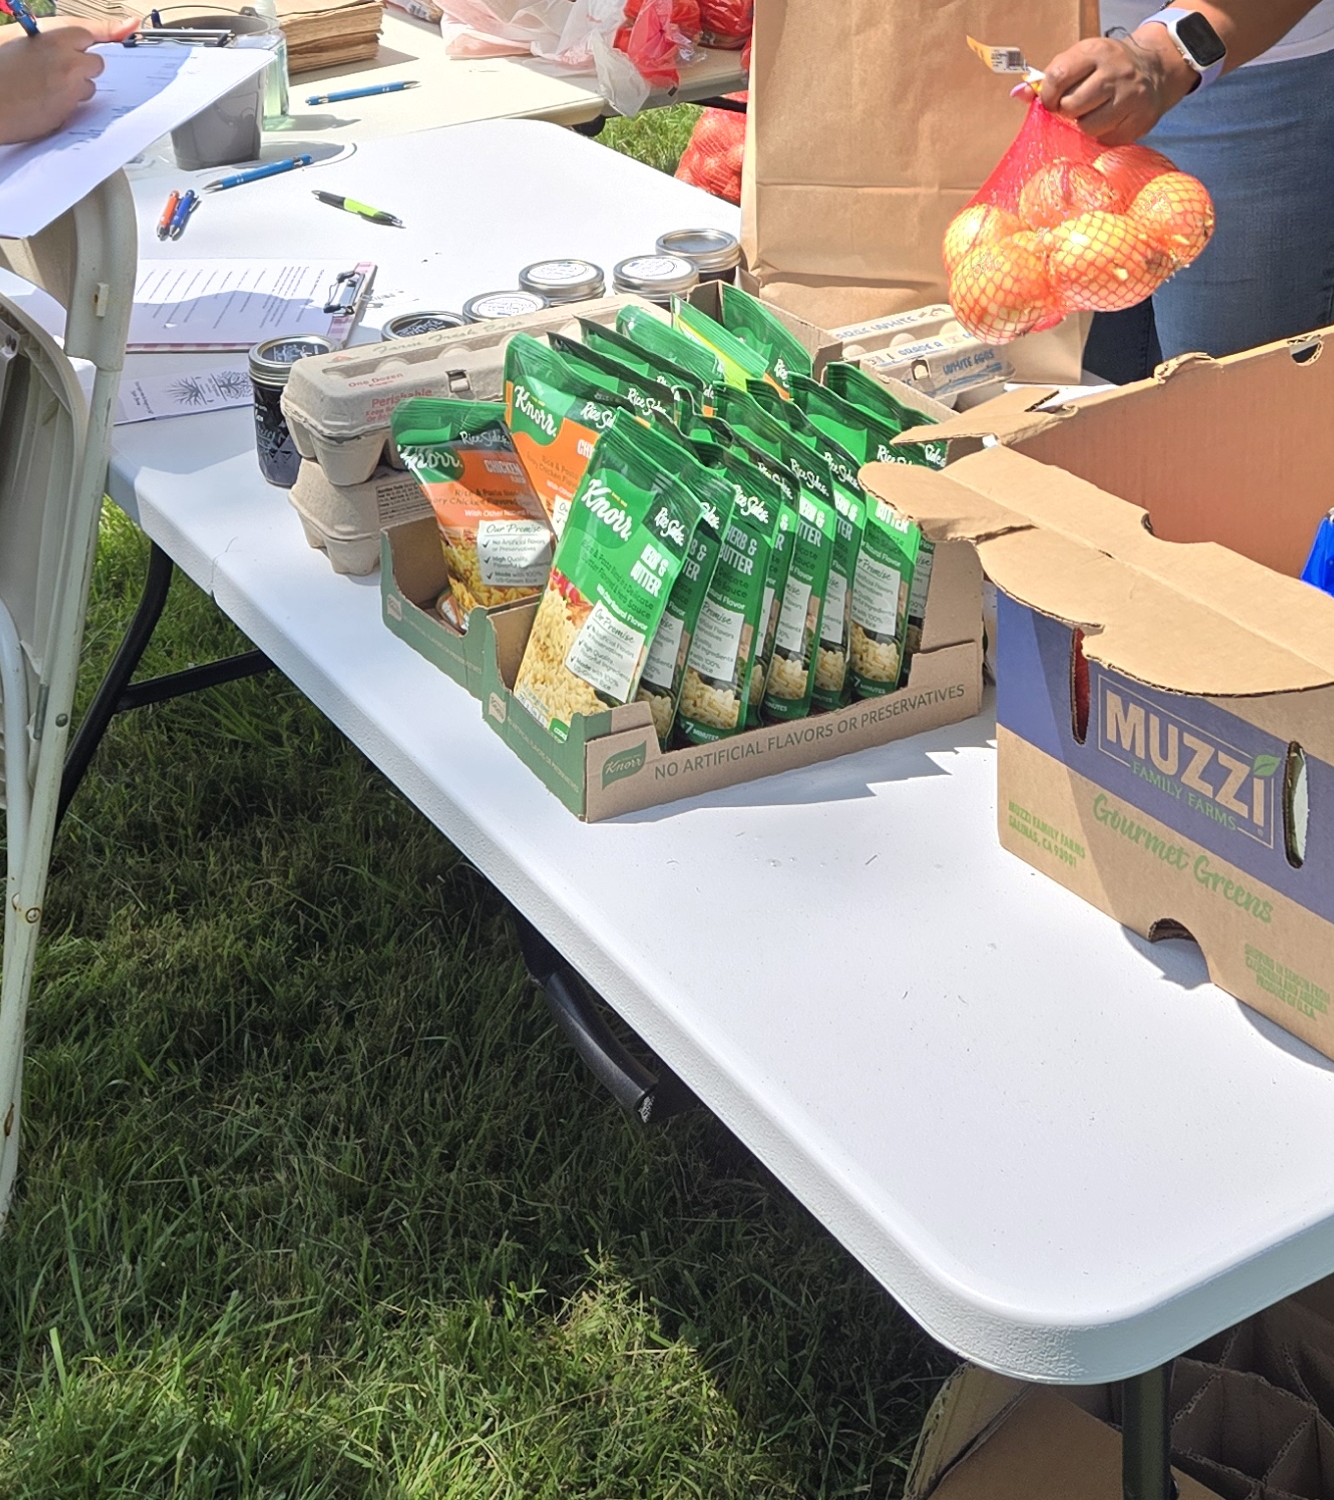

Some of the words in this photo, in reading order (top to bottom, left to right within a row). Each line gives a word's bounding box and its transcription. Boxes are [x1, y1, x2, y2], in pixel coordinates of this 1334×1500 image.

[371, 372, 405, 384] Dozen
[371, 387, 433, 409] Perishable
[514, 385, 558, 439] Knorr
[579, 401, 602, 422] Rice
[459, 430, 483, 445] Rice
[481, 428, 511, 448] Sides
[483, 458, 524, 477] CHICKEN
[805, 471, 830, 497] Sides
[581, 478, 634, 542] Knorr
[486, 523, 504, 534] Our
[505, 523, 542, 534] Promise
[798, 520, 823, 548] TTER
[747, 538, 758, 556] &
[719, 543, 754, 576] BUTTER
[602, 616, 635, 644] Promise
[655, 759, 680, 781] NO
[682, 740, 766, 772] ARTIFICIAL
[767, 723, 835, 751] FLAVORS
[837, 717, 859, 735] OR
[860, 683, 967, 729] PRESERVATIVES
[684, 720, 694, 735] 7
[603, 755, 644, 777] Knorr
[1131, 759, 1183, 801] FAMILY
[1187, 791, 1239, 833] FARMS
[1008, 799, 1033, 825] MUZZI
[1032, 814, 1060, 843] FAMILY
[1060, 832, 1086, 860] FARMS
[1042, 837, 1054, 854] CA
[1092, 793, 1190, 871] Gourmet
[1193, 854, 1274, 925] Greens
